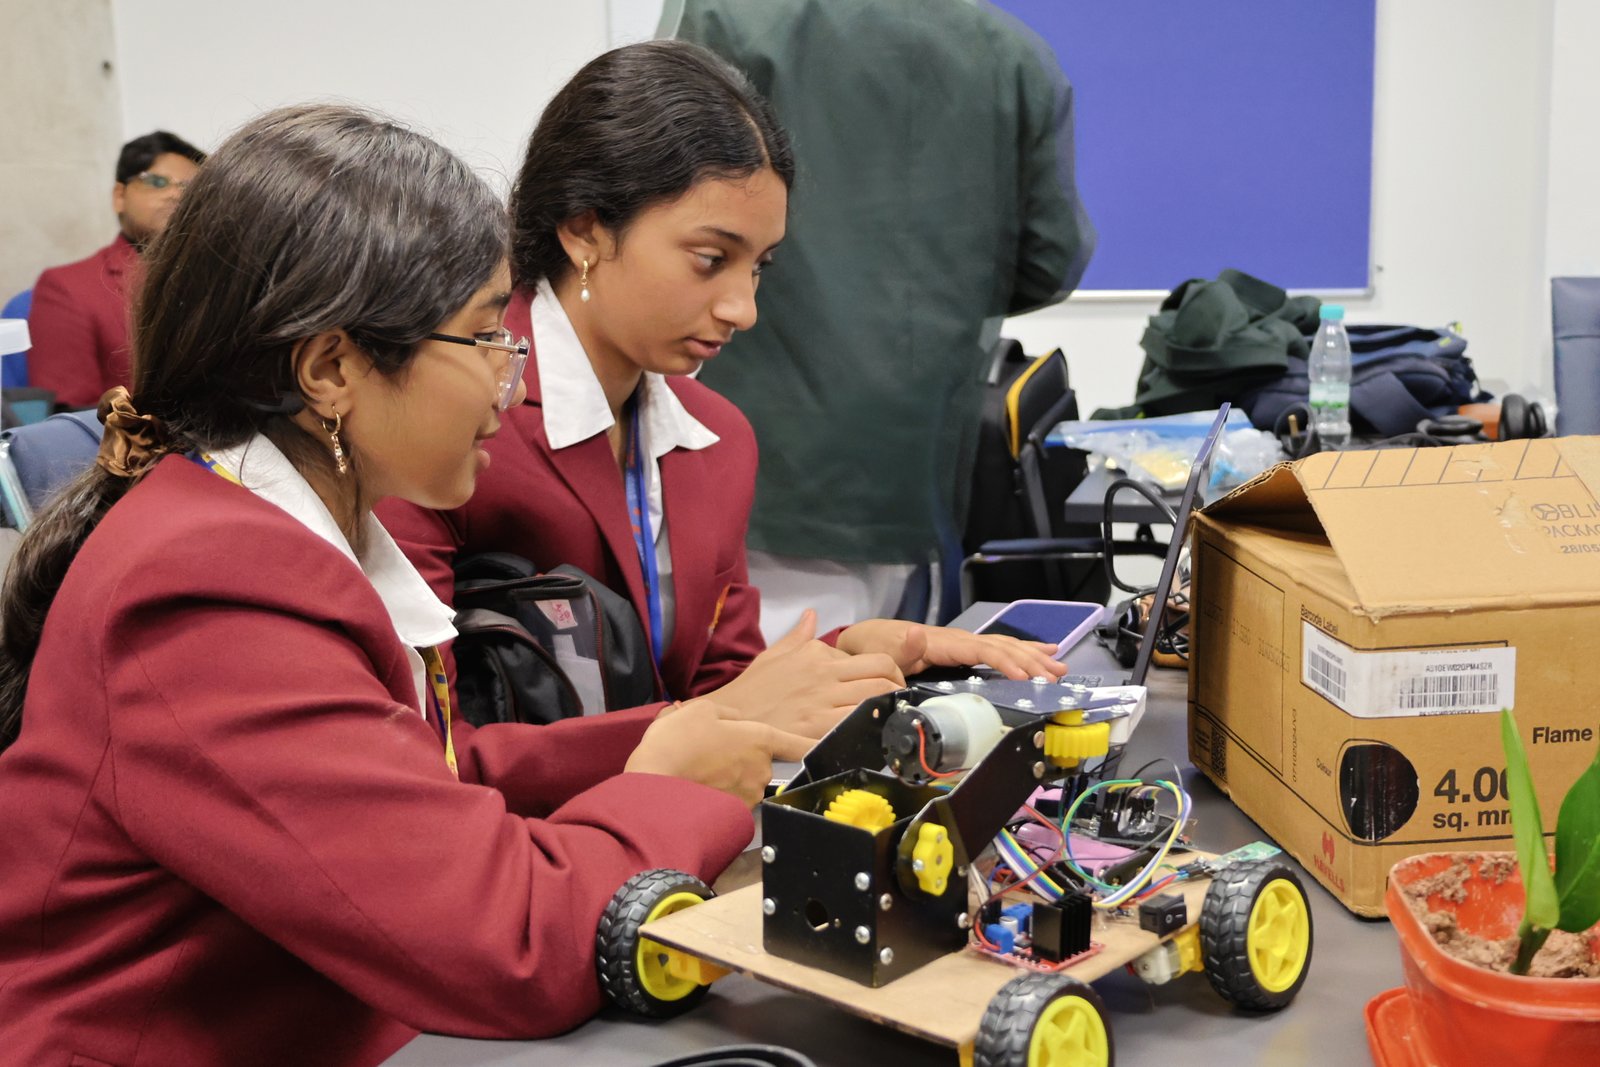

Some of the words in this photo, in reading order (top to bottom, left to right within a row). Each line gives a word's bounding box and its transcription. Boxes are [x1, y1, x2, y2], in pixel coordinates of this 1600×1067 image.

[1560, 543, 1600, 554] 28/05
[1532, 726, 1593, 744] Flame
[1432, 811, 1470, 832] sq.
